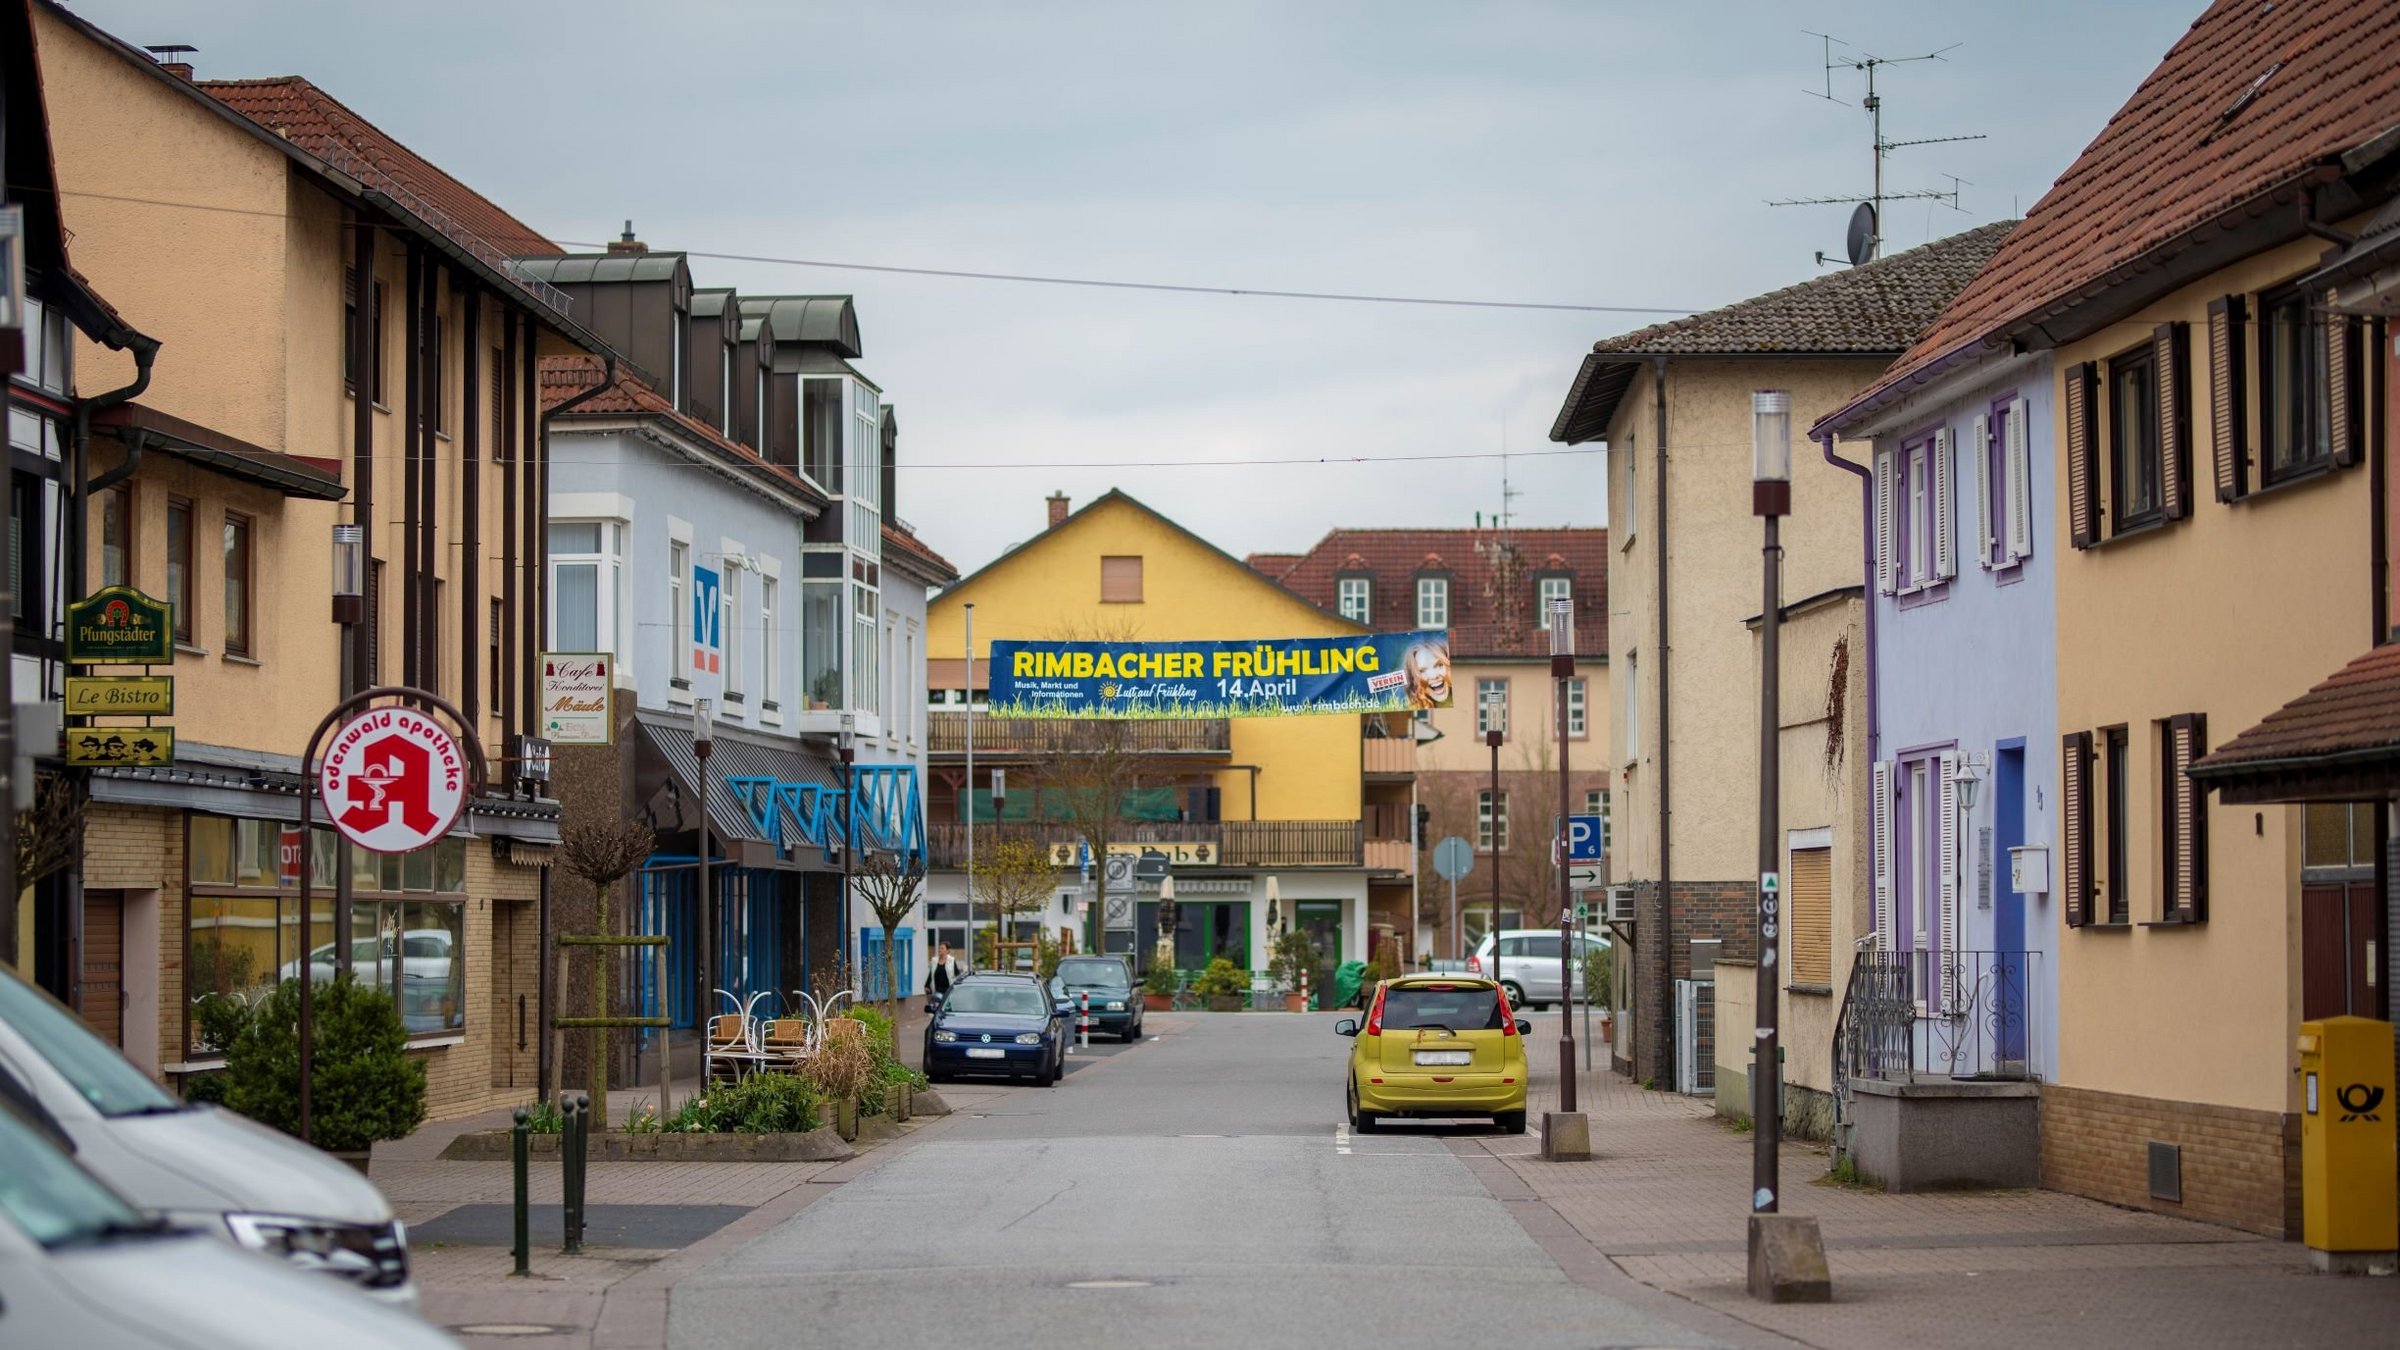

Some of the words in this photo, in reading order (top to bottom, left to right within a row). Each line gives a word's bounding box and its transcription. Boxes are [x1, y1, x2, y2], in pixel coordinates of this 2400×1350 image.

[80, 626, 156, 645] Pfungstädter
[1013, 651, 1205, 678] RIMBACHER
[1213, 645, 1379, 677] FRÜHLING
[546, 681, 604, 691] Konditorei
[1015, 681, 1039, 690] Musik,
[1041, 681, 1063, 689] Markt
[1064, 681, 1079, 689] und
[1217, 678, 1297, 699] 14.April
[1372, 674, 1404, 688] VEREIN
[77, 689, 99, 704] Le
[105, 687, 160, 704] Bistro
[1031, 690, 1084, 698] Informationen
[1116, 684, 1137, 698] Lust
[1138, 684, 1156, 698] auf
[1156, 683, 1198, 700] Frühling
[545, 696, 605, 712] Mäule
[326, 712, 391, 790] odenwald
[398, 717, 461, 792] apotheke
[1569, 822, 1591, 855] P
[1587, 845, 1596, 855] 6
